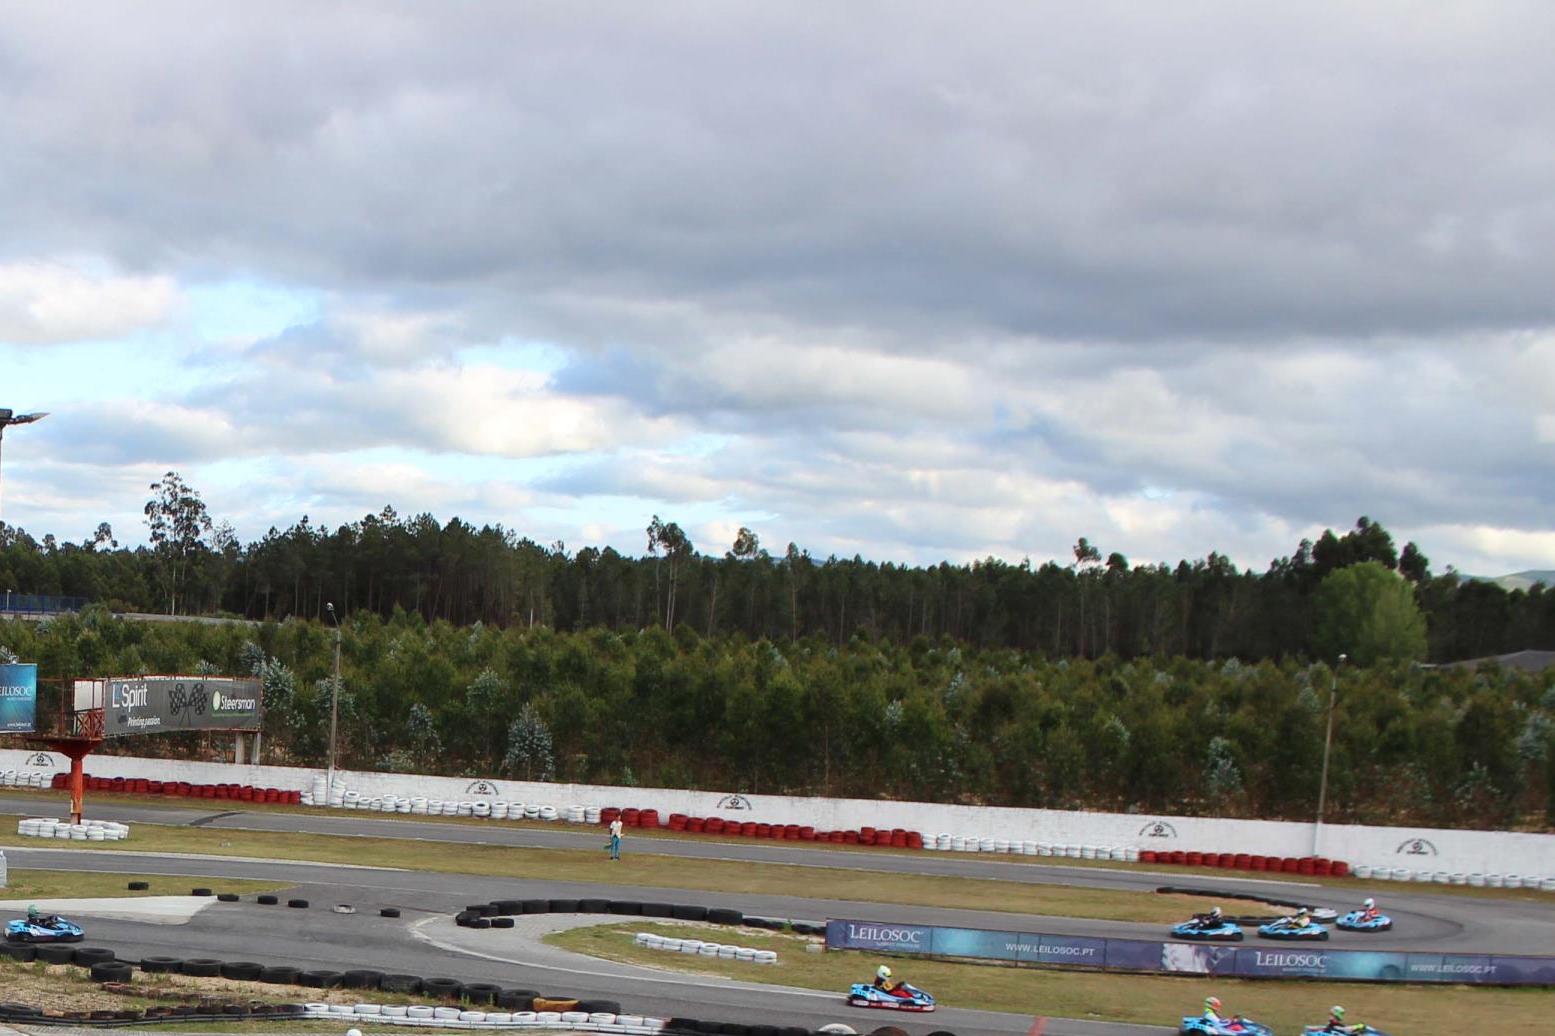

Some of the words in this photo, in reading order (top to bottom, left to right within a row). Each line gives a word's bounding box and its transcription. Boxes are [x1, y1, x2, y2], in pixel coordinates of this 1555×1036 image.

[220, 694, 256, 711] Steersman
[849, 924, 921, 943] LEILOSOC
[1005, 943, 1095, 956] WWW.LEILOSOC.PT
[1255, 951, 1326, 968] LEILOSOC
